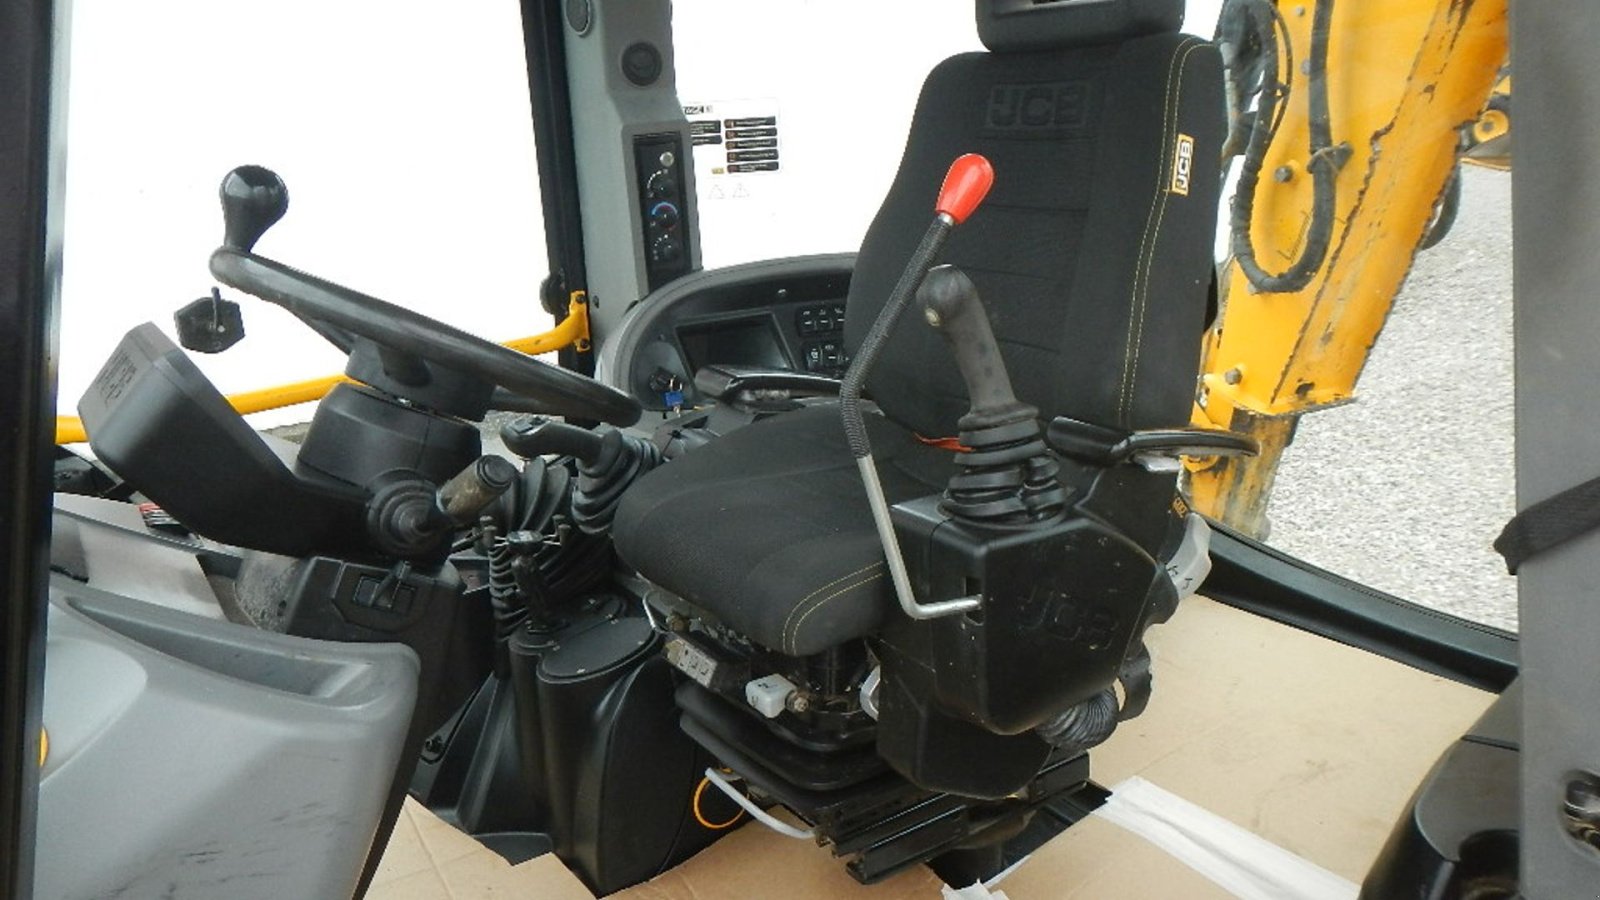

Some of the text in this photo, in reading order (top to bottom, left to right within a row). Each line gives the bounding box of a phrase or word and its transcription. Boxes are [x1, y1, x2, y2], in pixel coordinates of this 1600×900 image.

[988, 85, 1089, 128] JCB
[1174, 138, 1193, 191] JCB
[1017, 584, 1120, 651] JCB
